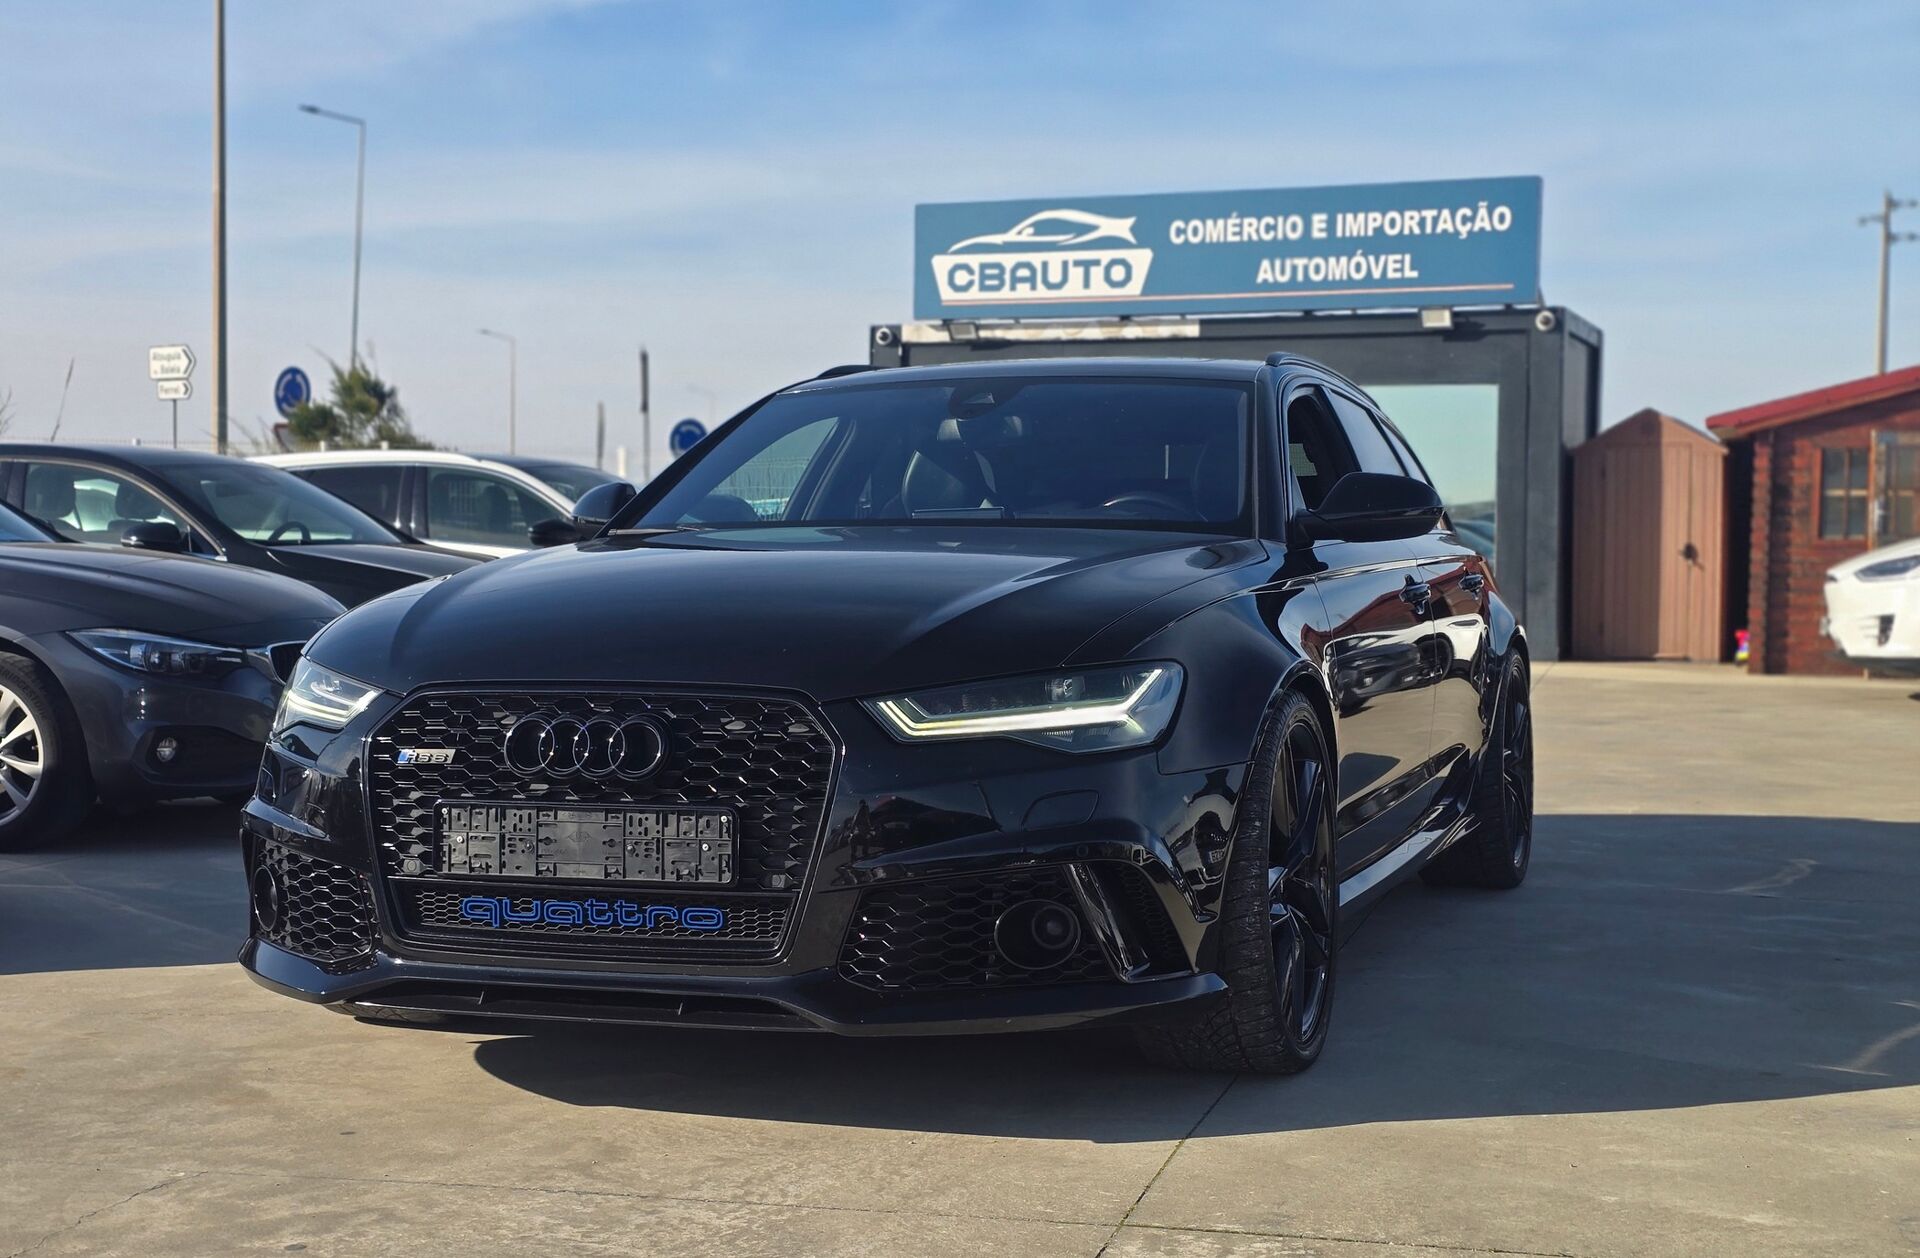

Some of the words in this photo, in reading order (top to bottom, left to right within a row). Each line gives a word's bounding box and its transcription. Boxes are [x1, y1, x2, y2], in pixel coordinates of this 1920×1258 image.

[1169, 211, 1304, 244] COMÉRCIO
[1311, 213, 1328, 239] E
[1335, 201, 1512, 239] IMPORTAÇÃO
[947, 258, 1133, 293] CBAUTO
[1256, 249, 1419, 284] AUTOMÓVEL
[462, 897, 723, 930] quattro
